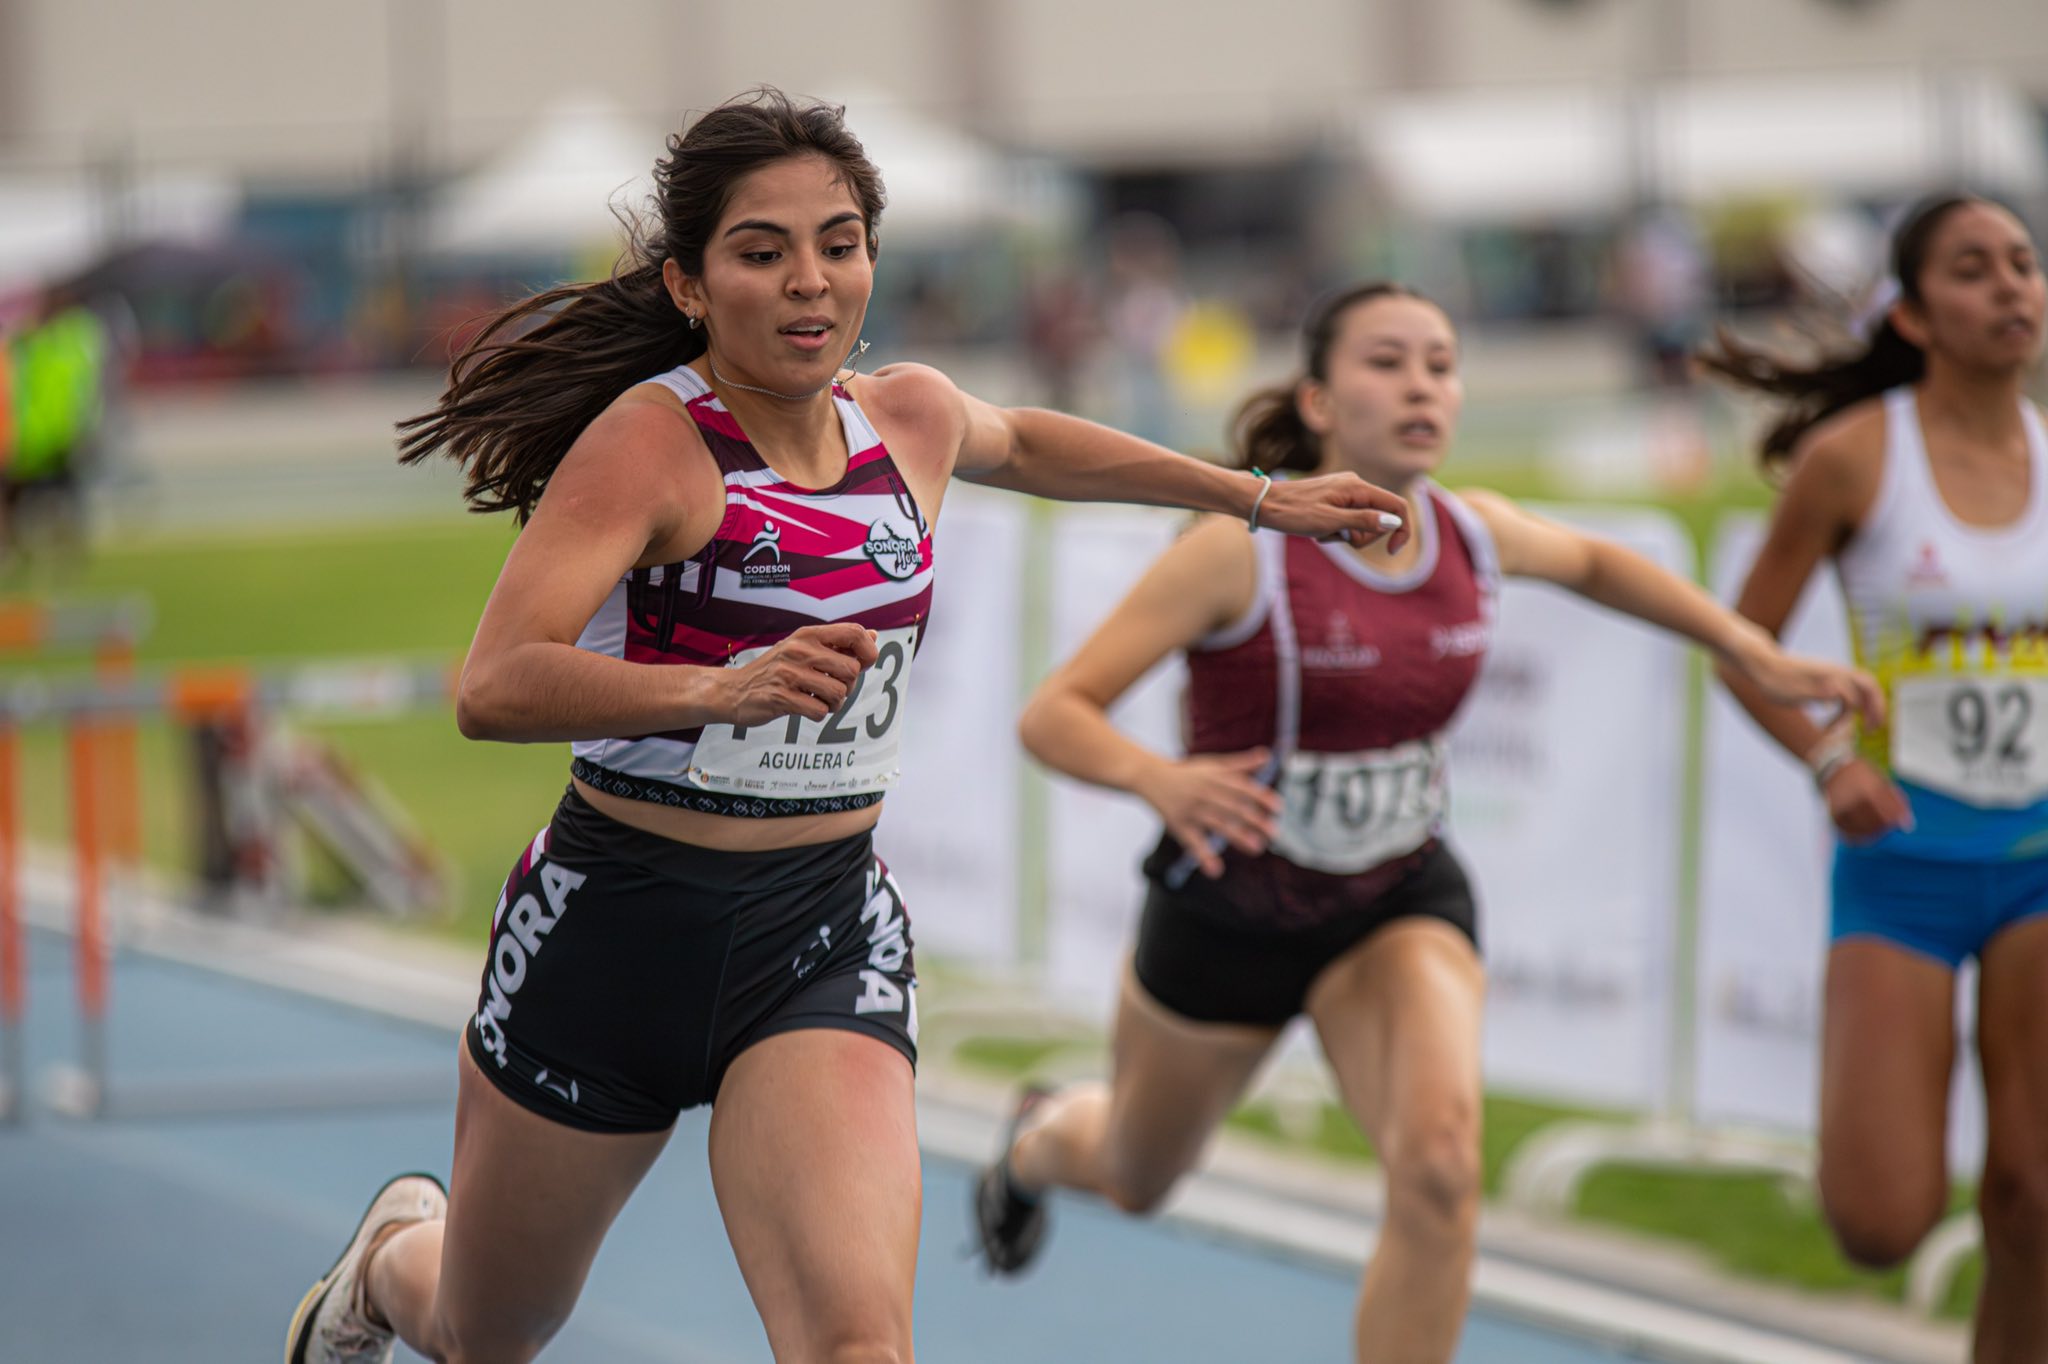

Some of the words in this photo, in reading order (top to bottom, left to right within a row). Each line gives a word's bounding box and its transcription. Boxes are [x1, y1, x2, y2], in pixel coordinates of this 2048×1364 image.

[865, 538, 915, 553] SONORA
[744, 564, 791, 574] CODESON
[732, 641, 904, 744] 23
[1948, 685, 2032, 763] 92
[758, 751, 842, 770] AGUILERA
[846, 750, 856, 767] C
